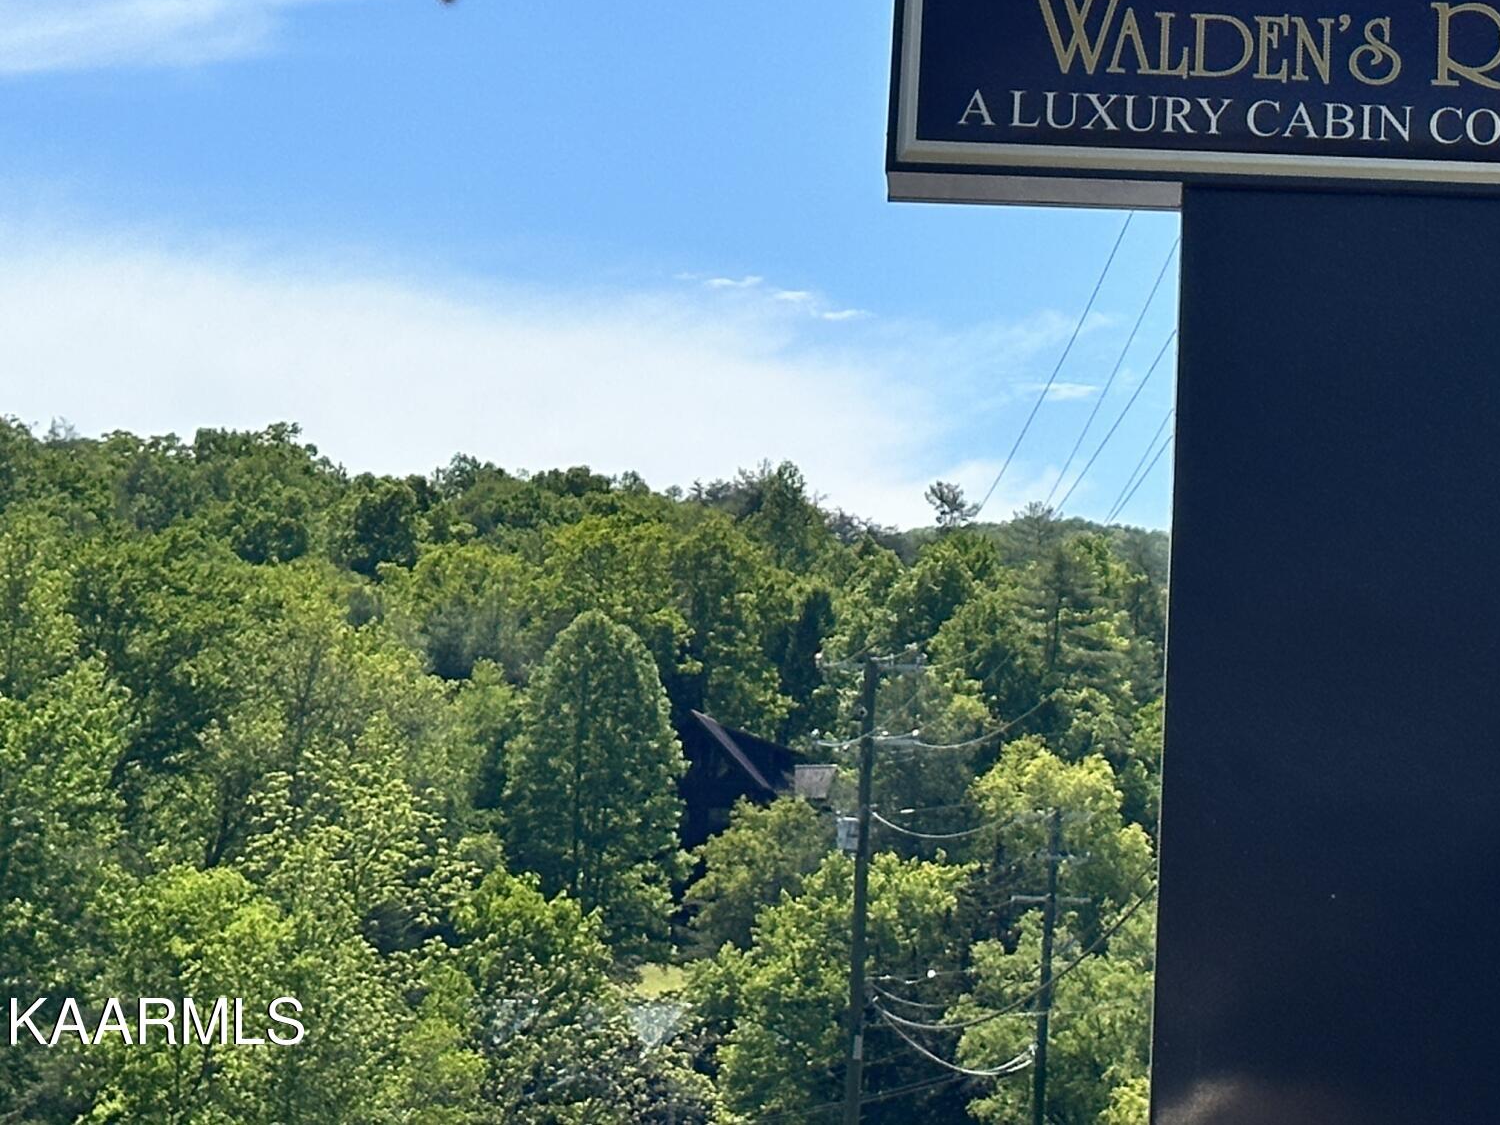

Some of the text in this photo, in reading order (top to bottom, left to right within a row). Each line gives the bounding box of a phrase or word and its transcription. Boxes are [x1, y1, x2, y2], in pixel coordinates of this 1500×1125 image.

[957, 88, 996, 127] A
[1008, 90, 1233, 135] LUXURY
[1247, 100, 1412, 142] CABIN
